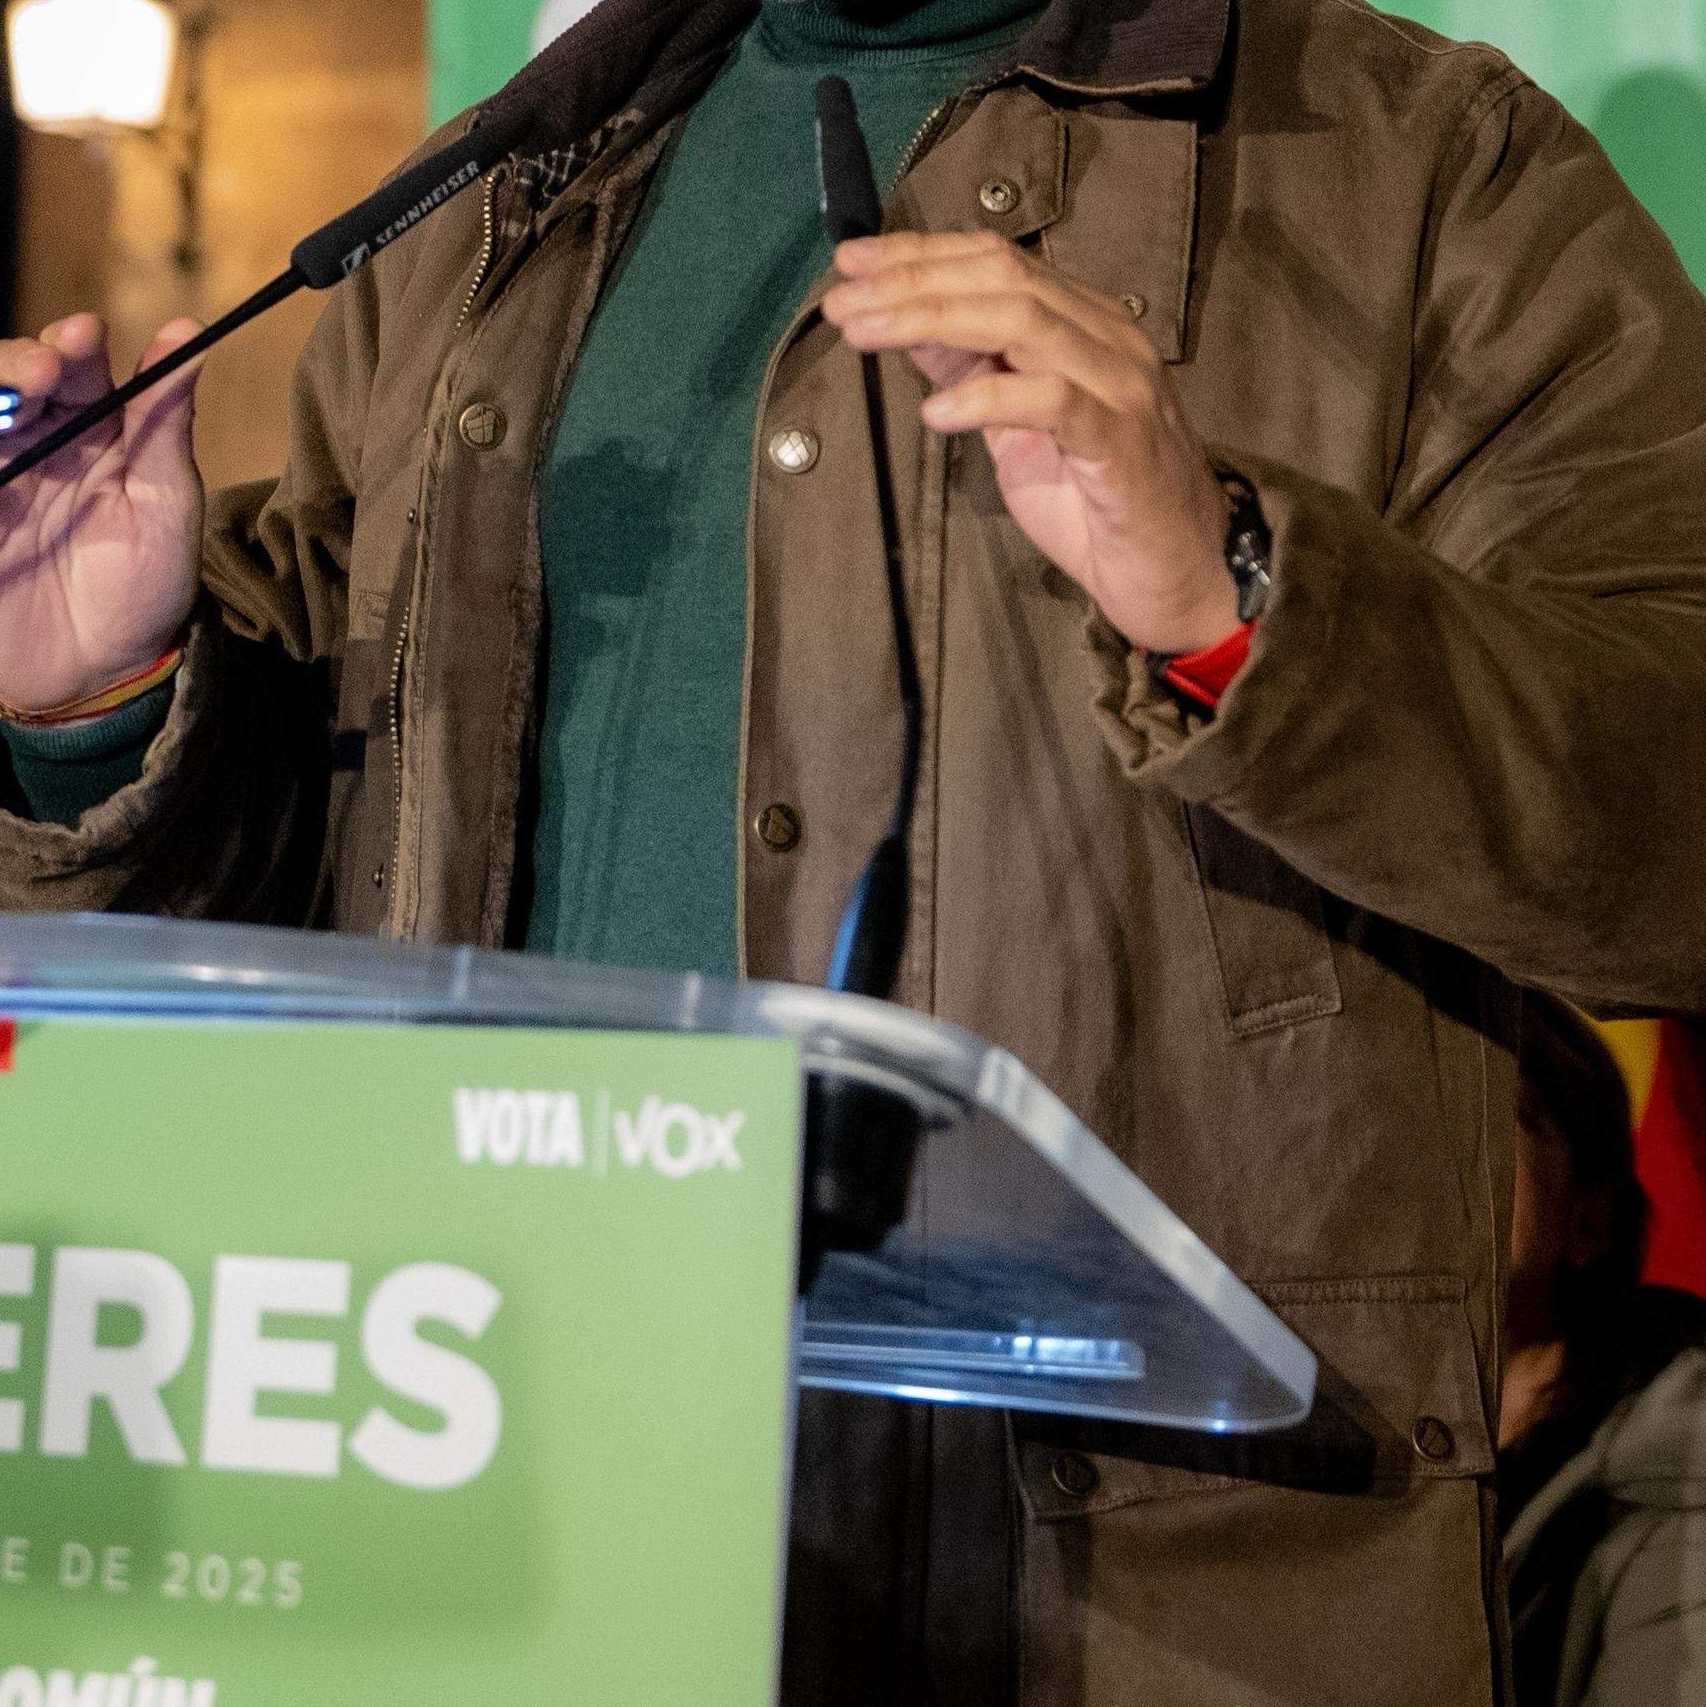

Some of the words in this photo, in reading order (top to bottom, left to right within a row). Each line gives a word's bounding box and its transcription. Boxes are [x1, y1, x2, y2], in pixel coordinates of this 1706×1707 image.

[375, 159, 480, 245] SENNHEISER
[454, 1087, 585, 1167] VOTA
[614, 1093, 745, 1179] VOX
[59, 1542, 134, 1594] DE
[162, 1550, 304, 1610] 2025
